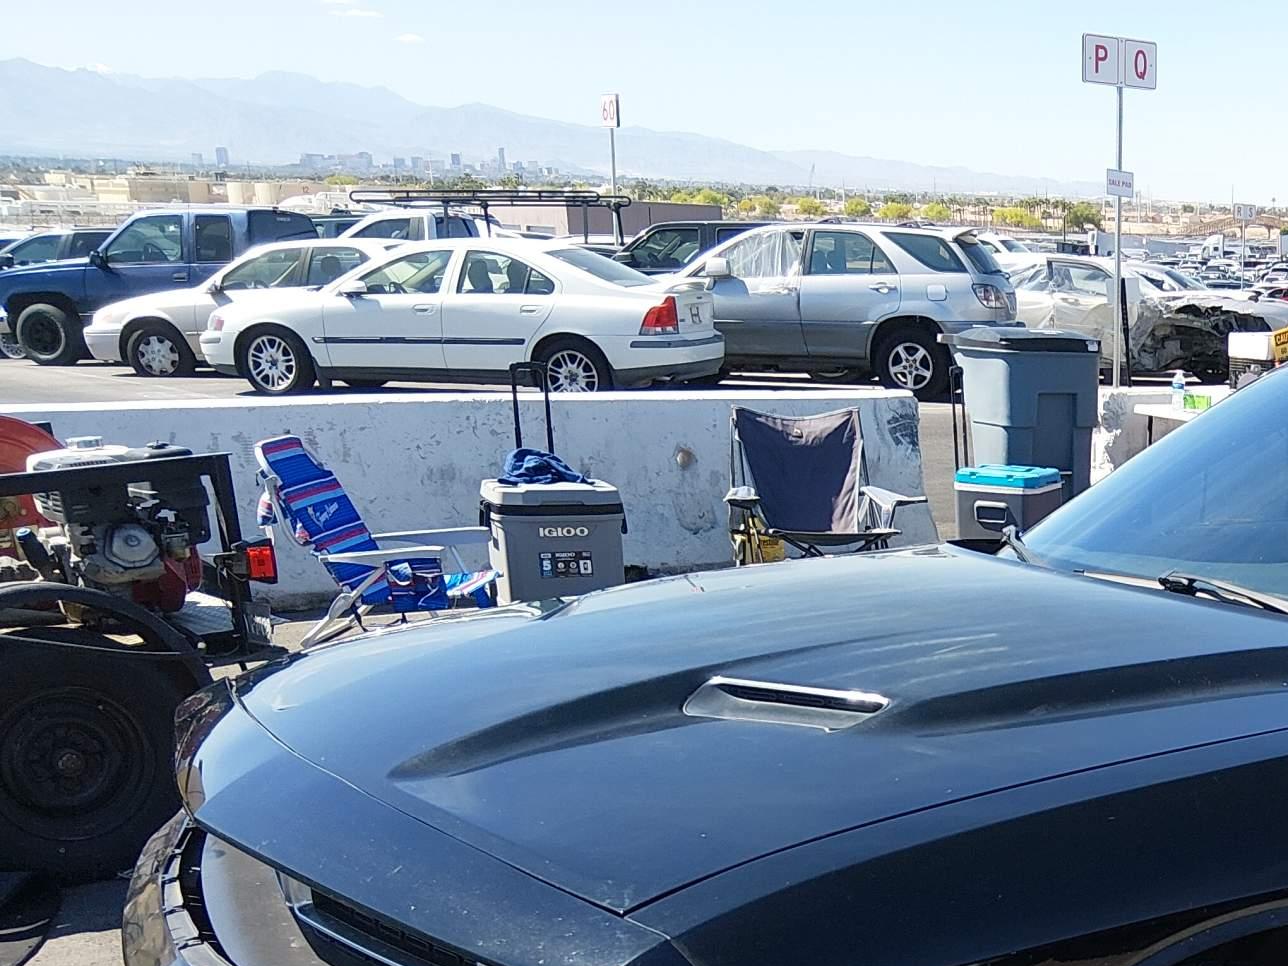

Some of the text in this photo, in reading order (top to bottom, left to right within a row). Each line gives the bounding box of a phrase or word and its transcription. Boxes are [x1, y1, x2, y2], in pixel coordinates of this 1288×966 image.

[1095, 44, 1148, 80] P Q
[539, 527, 589, 537] IGLOO
[542, 560, 552, 571] 5
